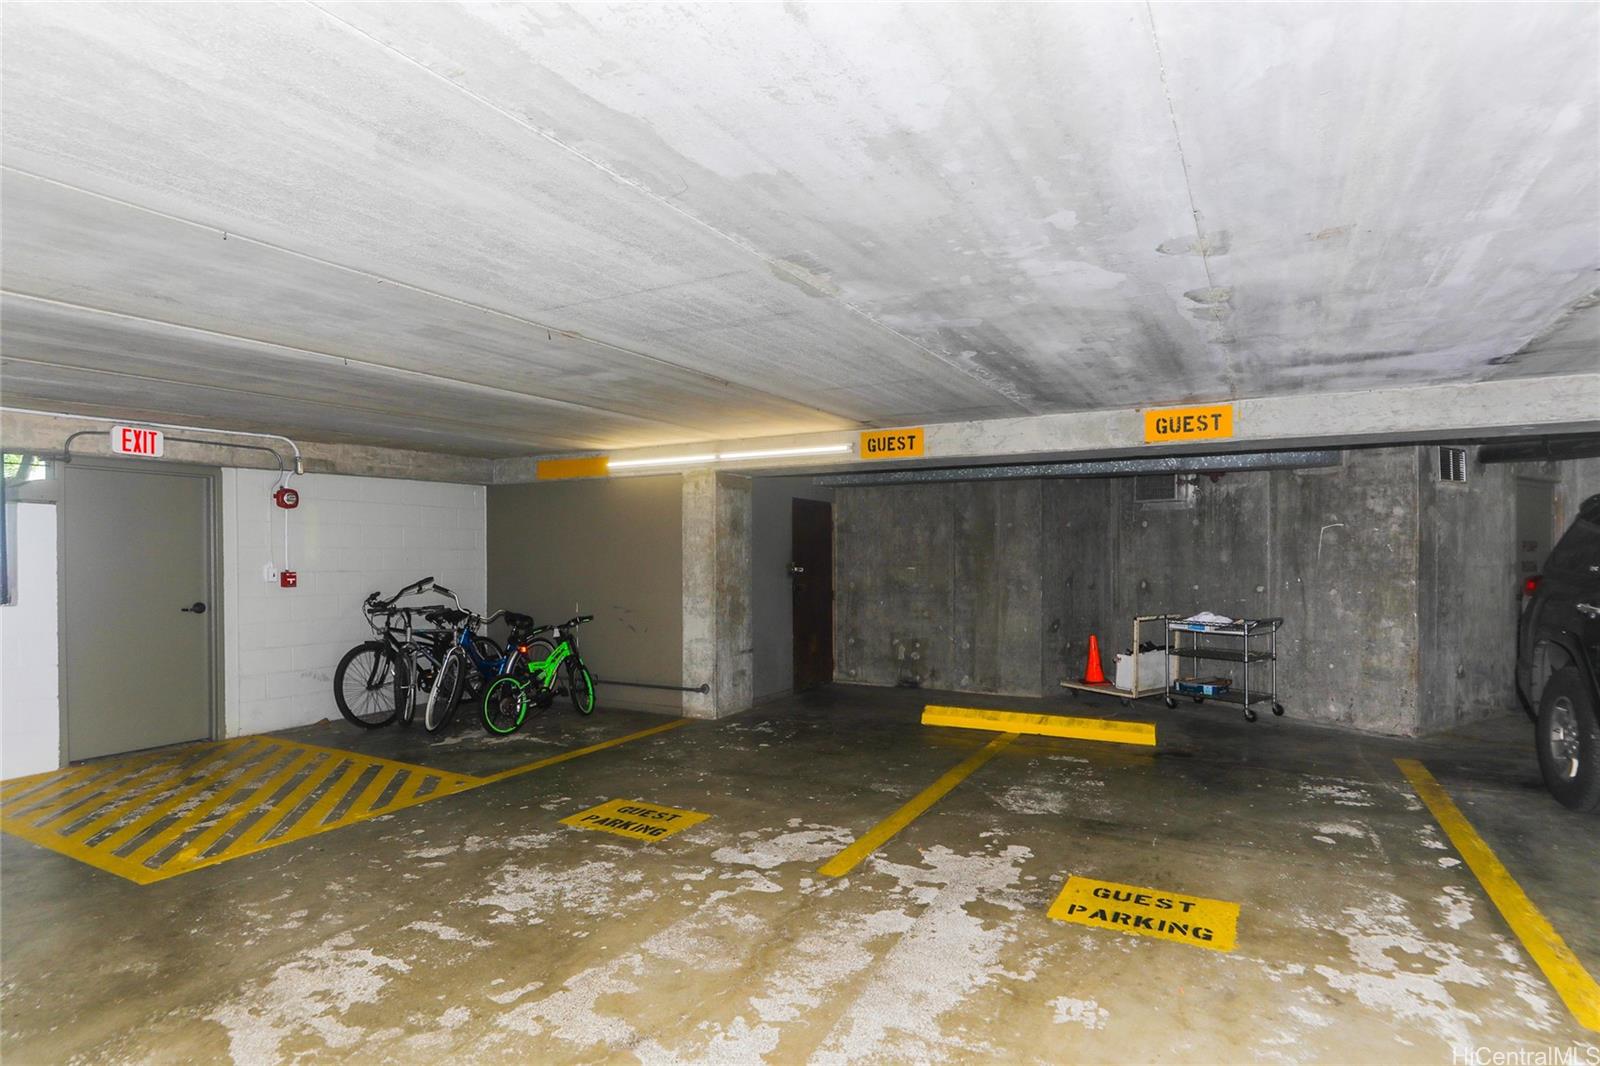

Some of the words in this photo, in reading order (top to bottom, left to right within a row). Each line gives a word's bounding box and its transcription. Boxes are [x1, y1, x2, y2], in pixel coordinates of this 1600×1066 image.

[1156, 413, 1222, 434] GUEST
[122, 428, 158, 455] EXIT
[867, 435, 916, 452] GUEST
[580, 814, 668, 837] PARKING
[616, 806, 682, 822] GUEST
[1092, 887, 1196, 913] GUEST
[1067, 903, 1214, 941] PARKING
